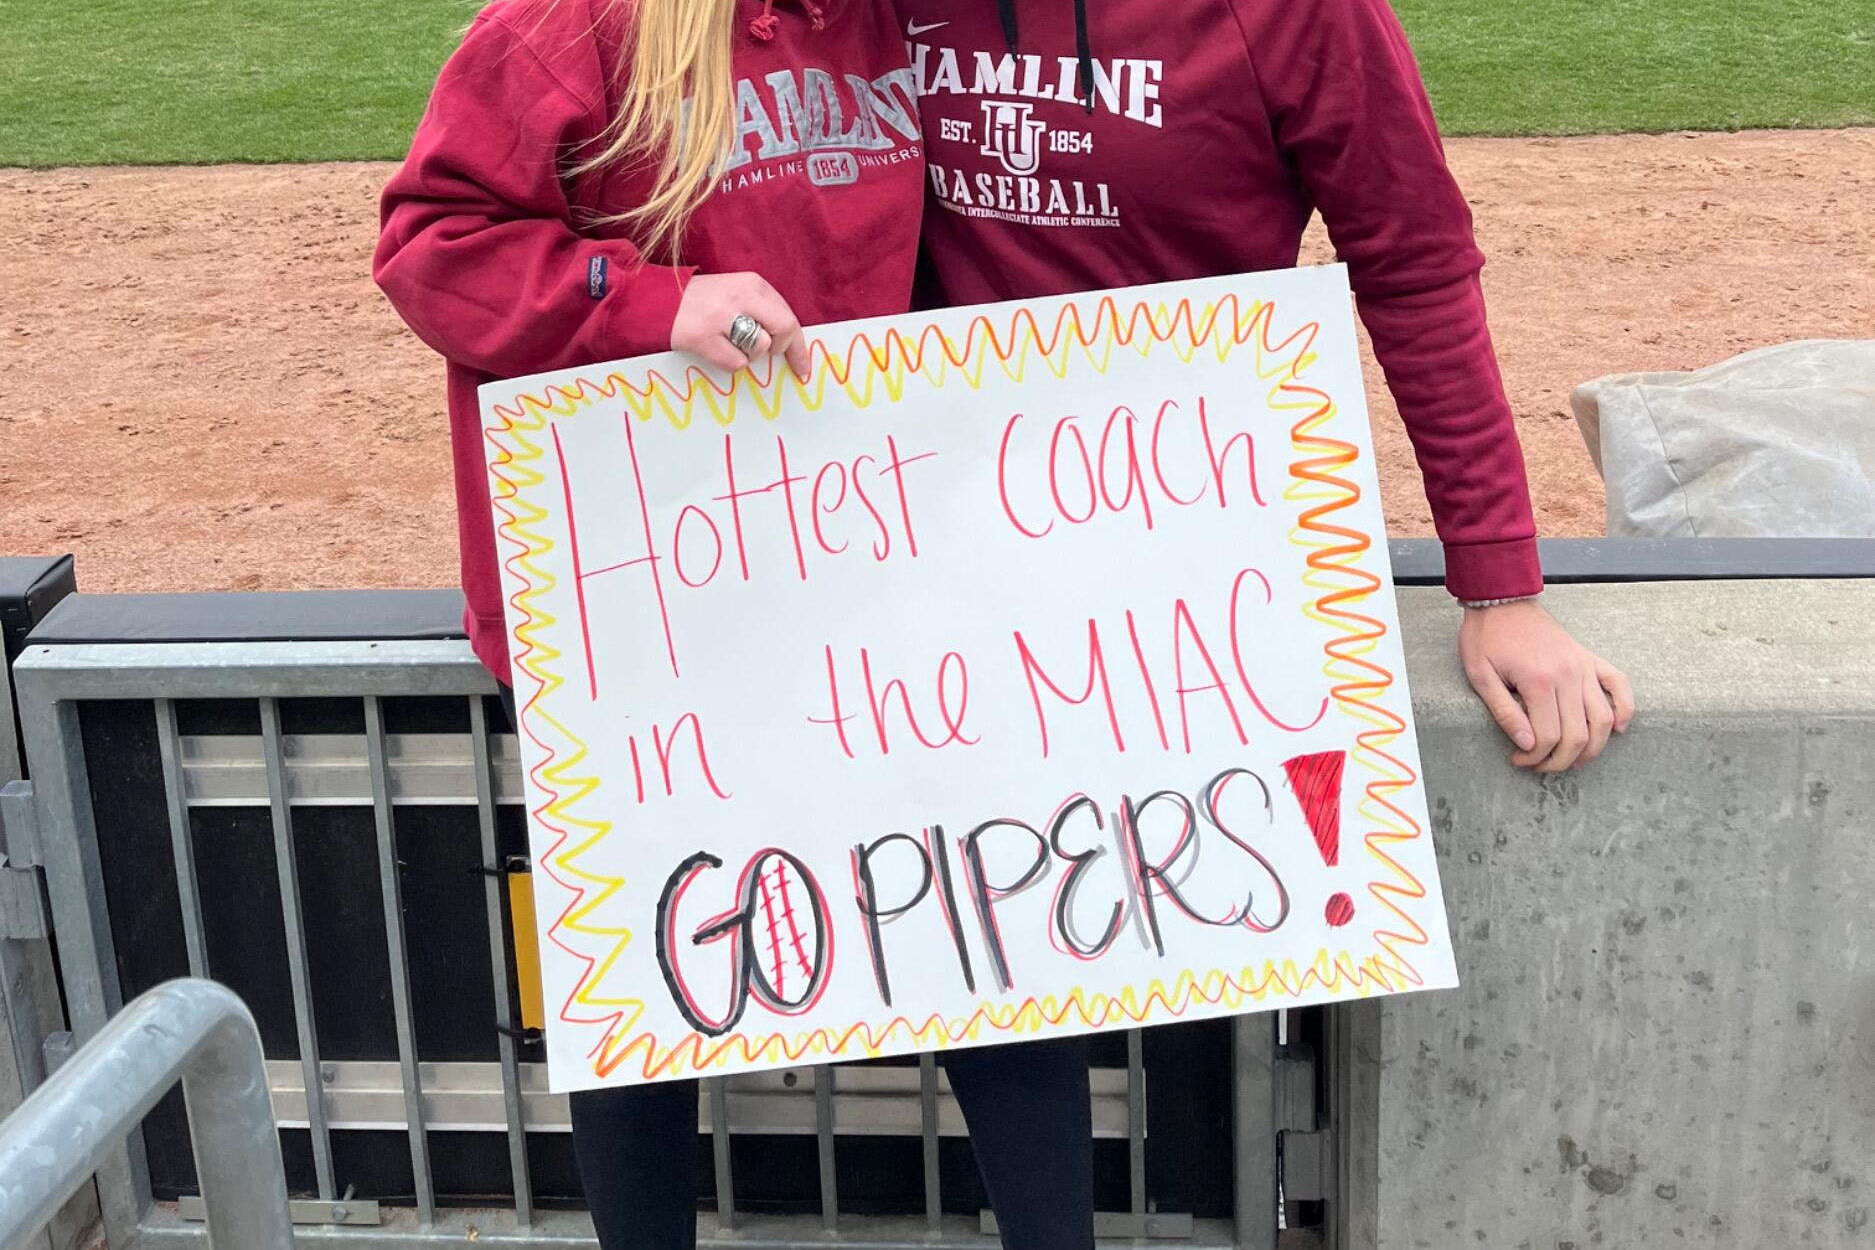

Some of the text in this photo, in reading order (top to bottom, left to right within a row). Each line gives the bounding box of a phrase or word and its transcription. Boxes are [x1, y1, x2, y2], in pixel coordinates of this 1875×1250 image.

[678, 68, 922, 180] AMLIN
[905, 41, 1163, 130] HAMLINE
[722, 160, 804, 194] HAMLINE
[814, 158, 850, 181] 1854
[940, 117, 977, 144] EST.
[1048, 130, 1093, 154] 1854
[928, 163, 1120, 218] BASEBALL
[1031, 216, 1069, 227] ATHLETIC
[1071, 217, 1121, 228] CONFERENCE
[551, 410, 938, 701] Hottest
[626, 566, 1331, 804] in the MIAC
[656, 844, 835, 1039] GO
